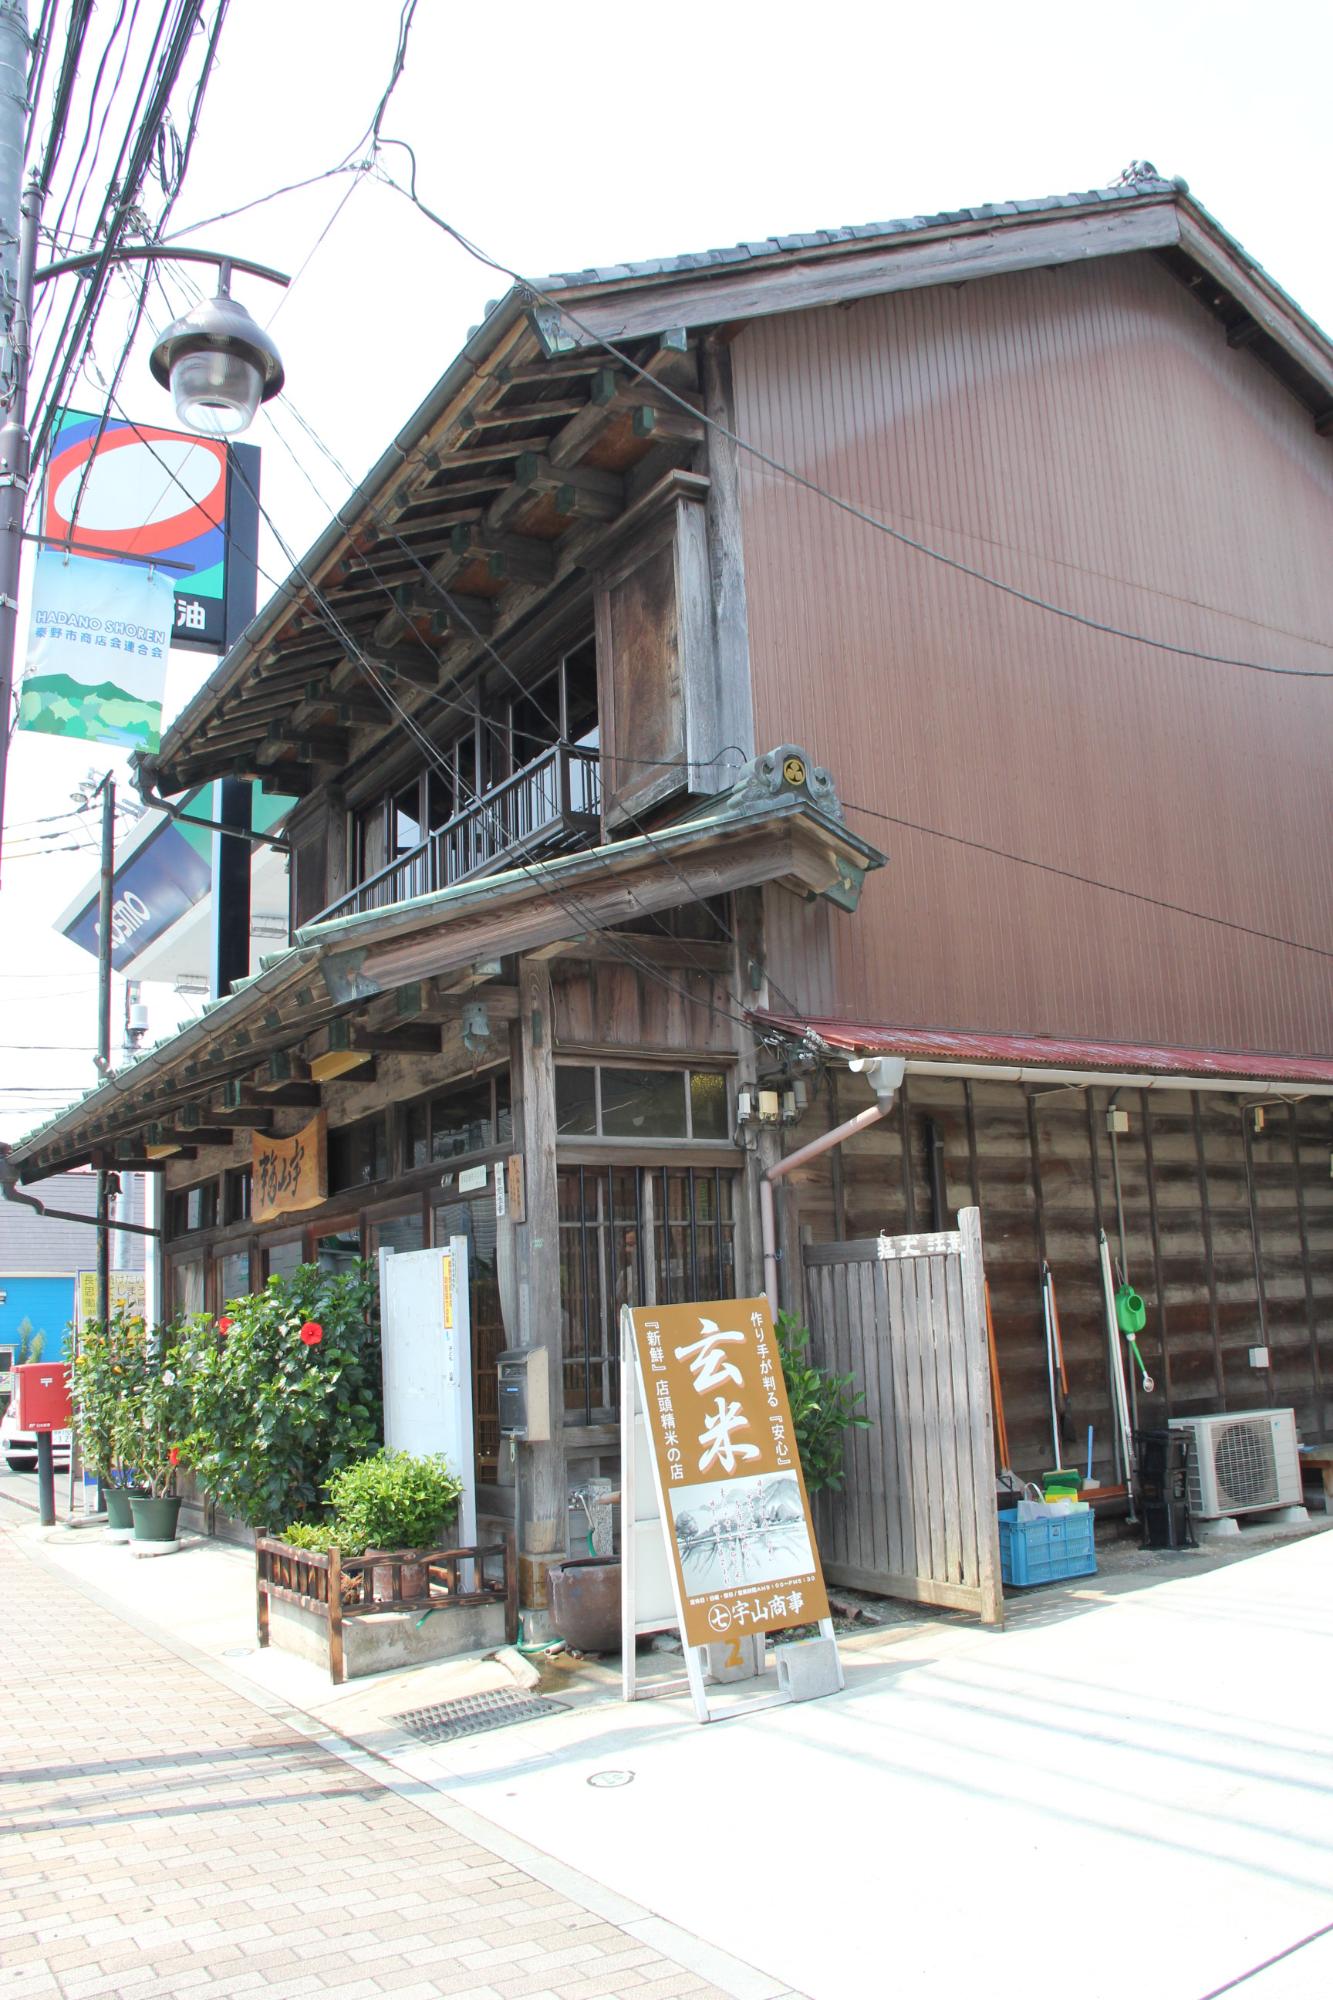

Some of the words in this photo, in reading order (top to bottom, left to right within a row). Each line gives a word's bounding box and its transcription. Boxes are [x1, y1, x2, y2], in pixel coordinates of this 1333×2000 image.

[34, 627, 163, 659] 秦野市商店会連合会
[36, 610, 101, 630] HADANO
[105, 620, 165, 645] SHOREN
[644, 1320, 684, 1480] 『新鮮』店頭精米の店
[674, 1317, 761, 1476] 玄米
[749, 1311, 791, 1467] 作り手が判る『安心』
[731, 1590, 805, 1626] 宇山商事
[723, 1638, 745, 1669] 2
